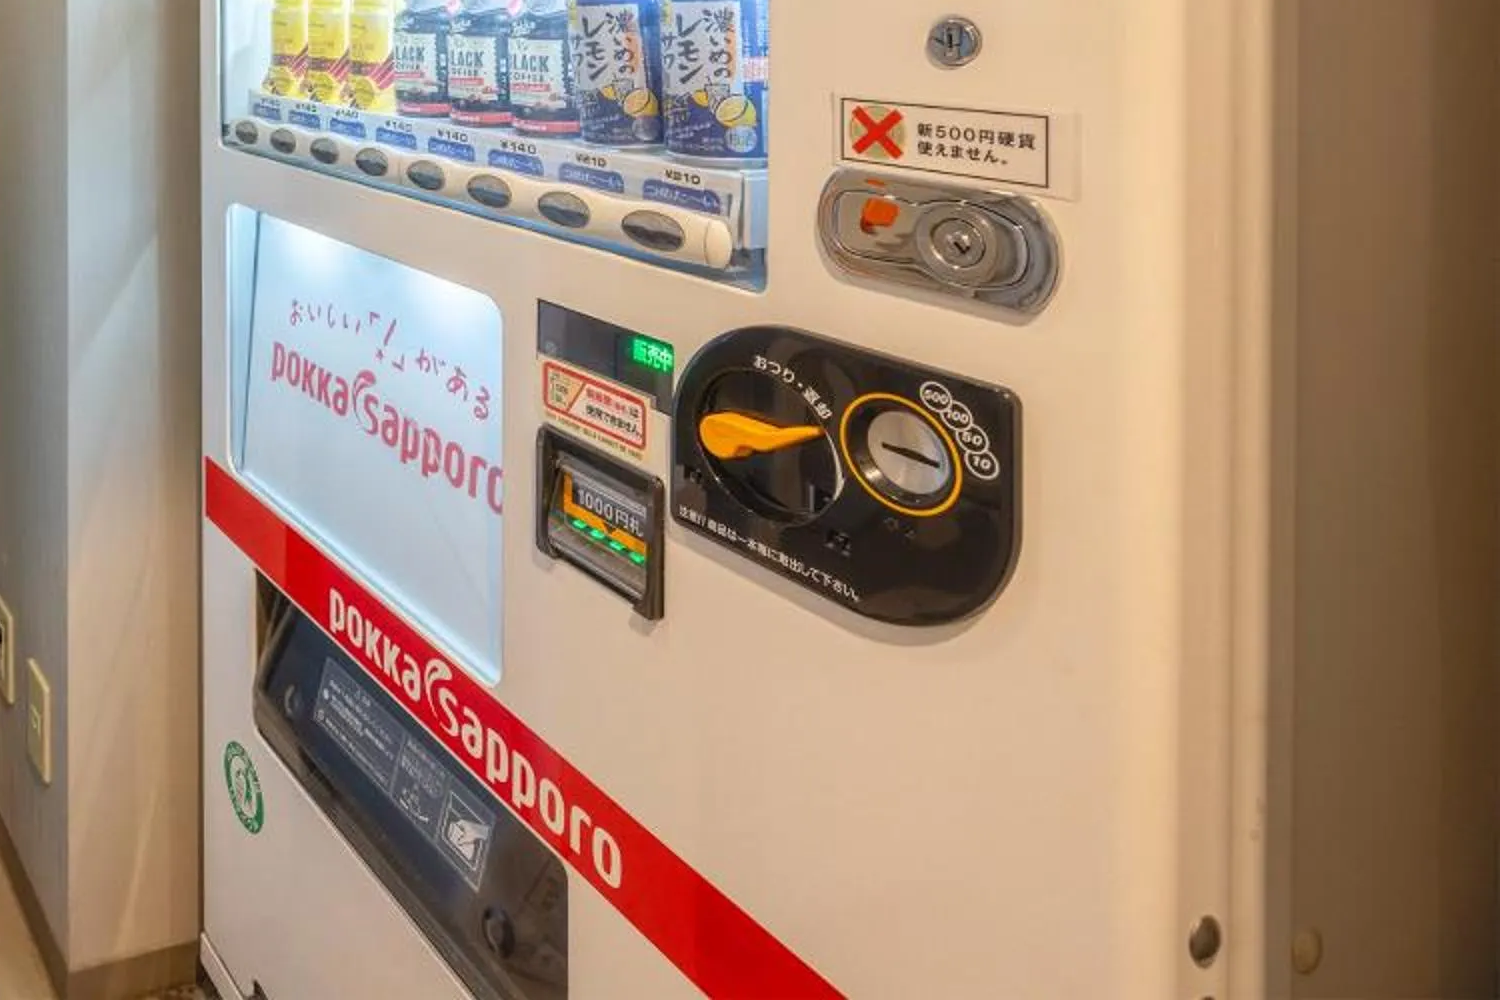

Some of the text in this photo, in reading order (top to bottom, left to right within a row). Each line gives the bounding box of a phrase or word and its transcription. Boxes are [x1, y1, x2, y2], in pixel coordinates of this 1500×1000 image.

[582, 16, 608, 81] レモン
[676, 12, 705, 84] レモン
[917, 122, 1036, 151] 新500円硬貨
[917, 140, 1008, 166] 使えません。
